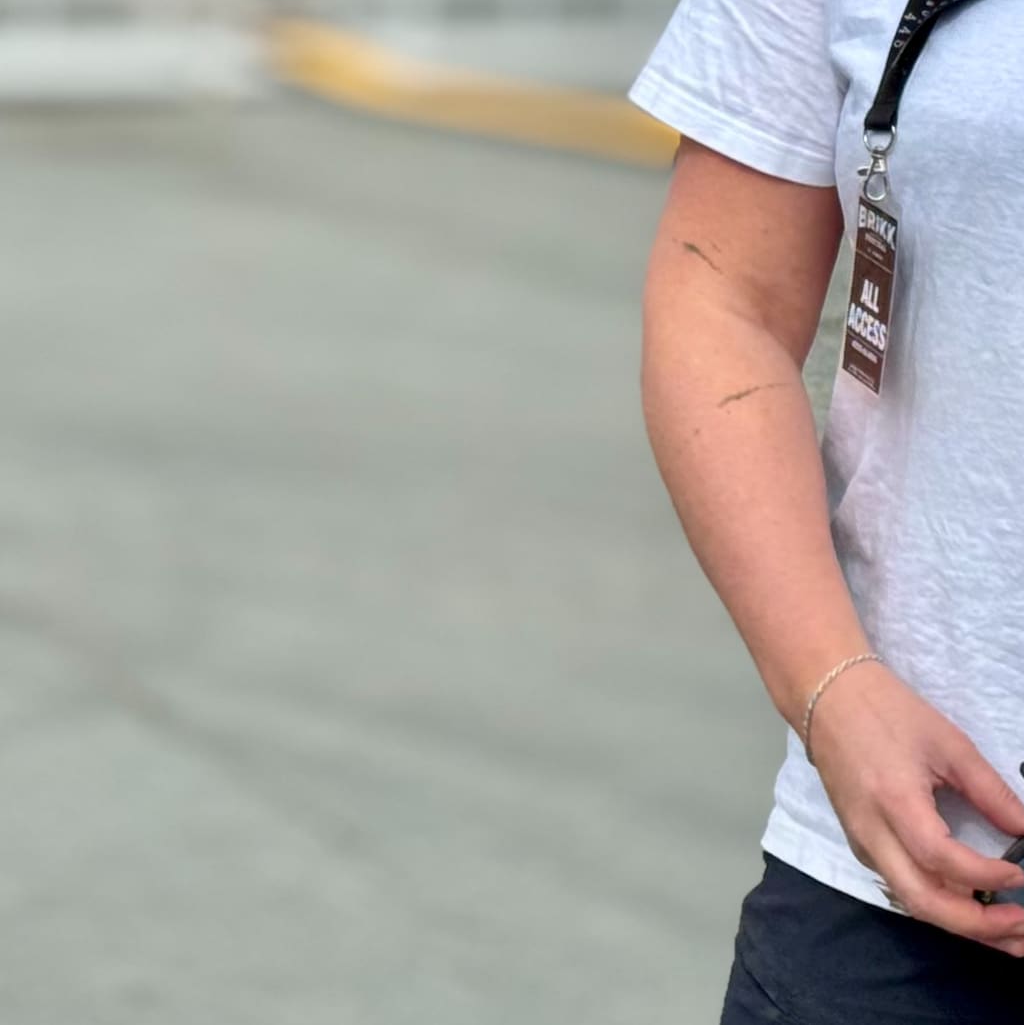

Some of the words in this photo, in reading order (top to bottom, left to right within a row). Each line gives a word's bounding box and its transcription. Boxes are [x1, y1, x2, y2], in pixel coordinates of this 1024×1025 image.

[858, 204, 896, 252] BRIKK
[860, 278, 880, 314] ALL
[848, 307, 887, 352] ACCESS
